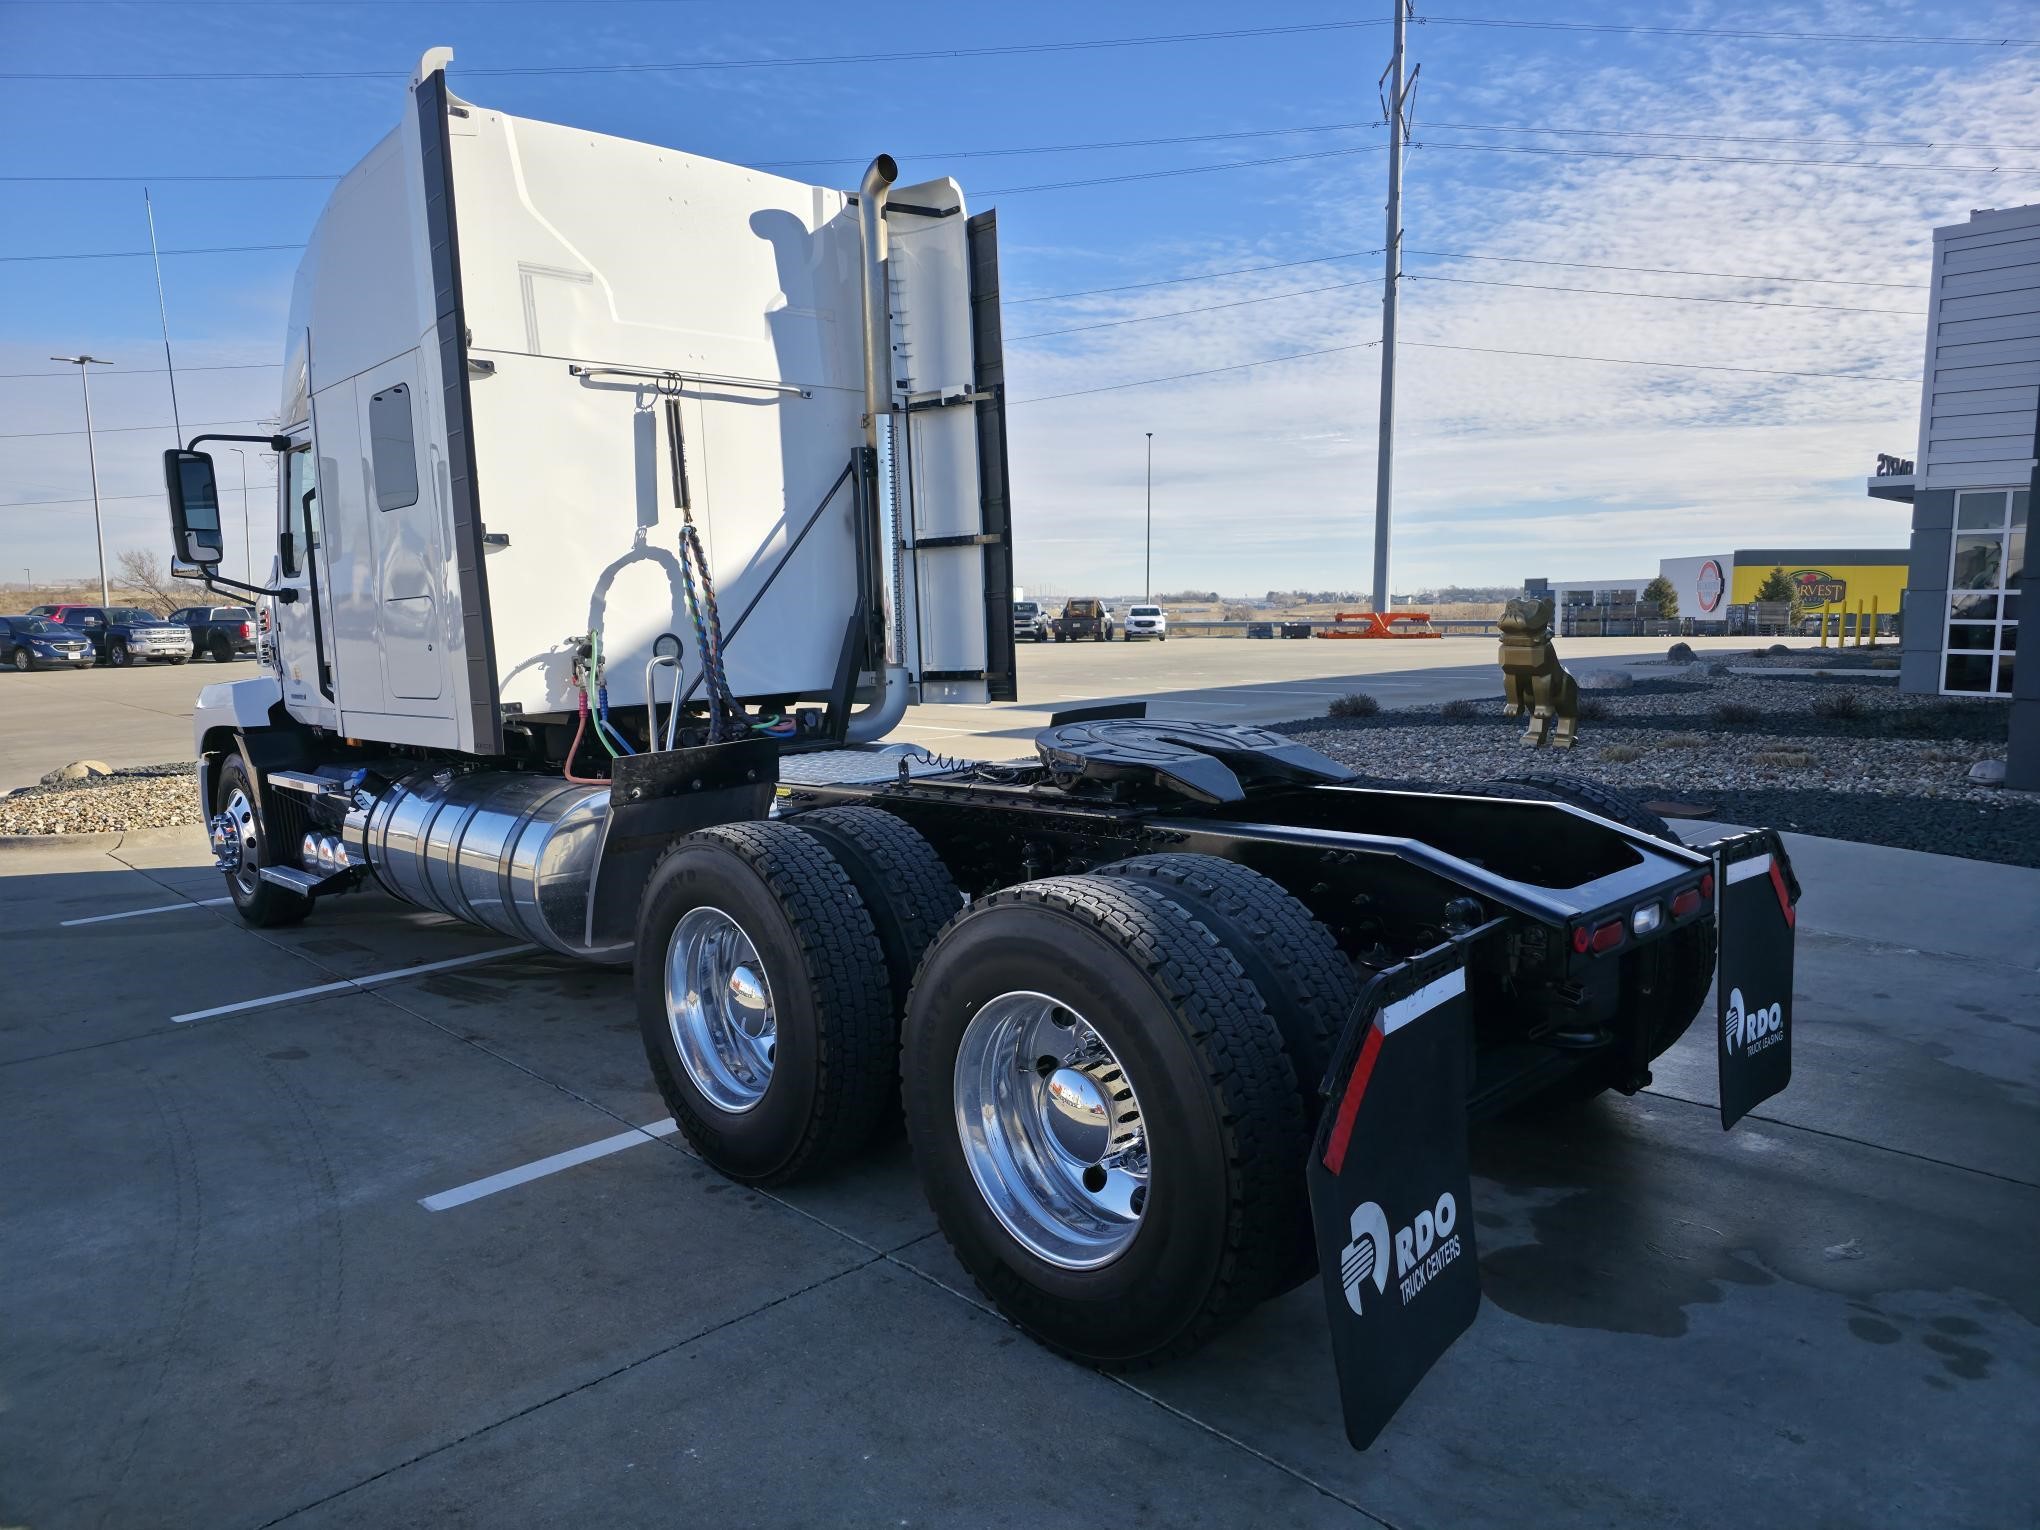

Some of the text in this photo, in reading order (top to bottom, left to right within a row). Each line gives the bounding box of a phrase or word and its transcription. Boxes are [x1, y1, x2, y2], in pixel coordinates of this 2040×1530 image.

[1794, 584, 1843, 601] RVEST
[1746, 1002, 1782, 1044] RDO
[1746, 1030, 1784, 1057] TRUCK LEASING
[1395, 1191, 1457, 1280] RDO
[1399, 1234, 1461, 1306] TRUCK CENTERS
